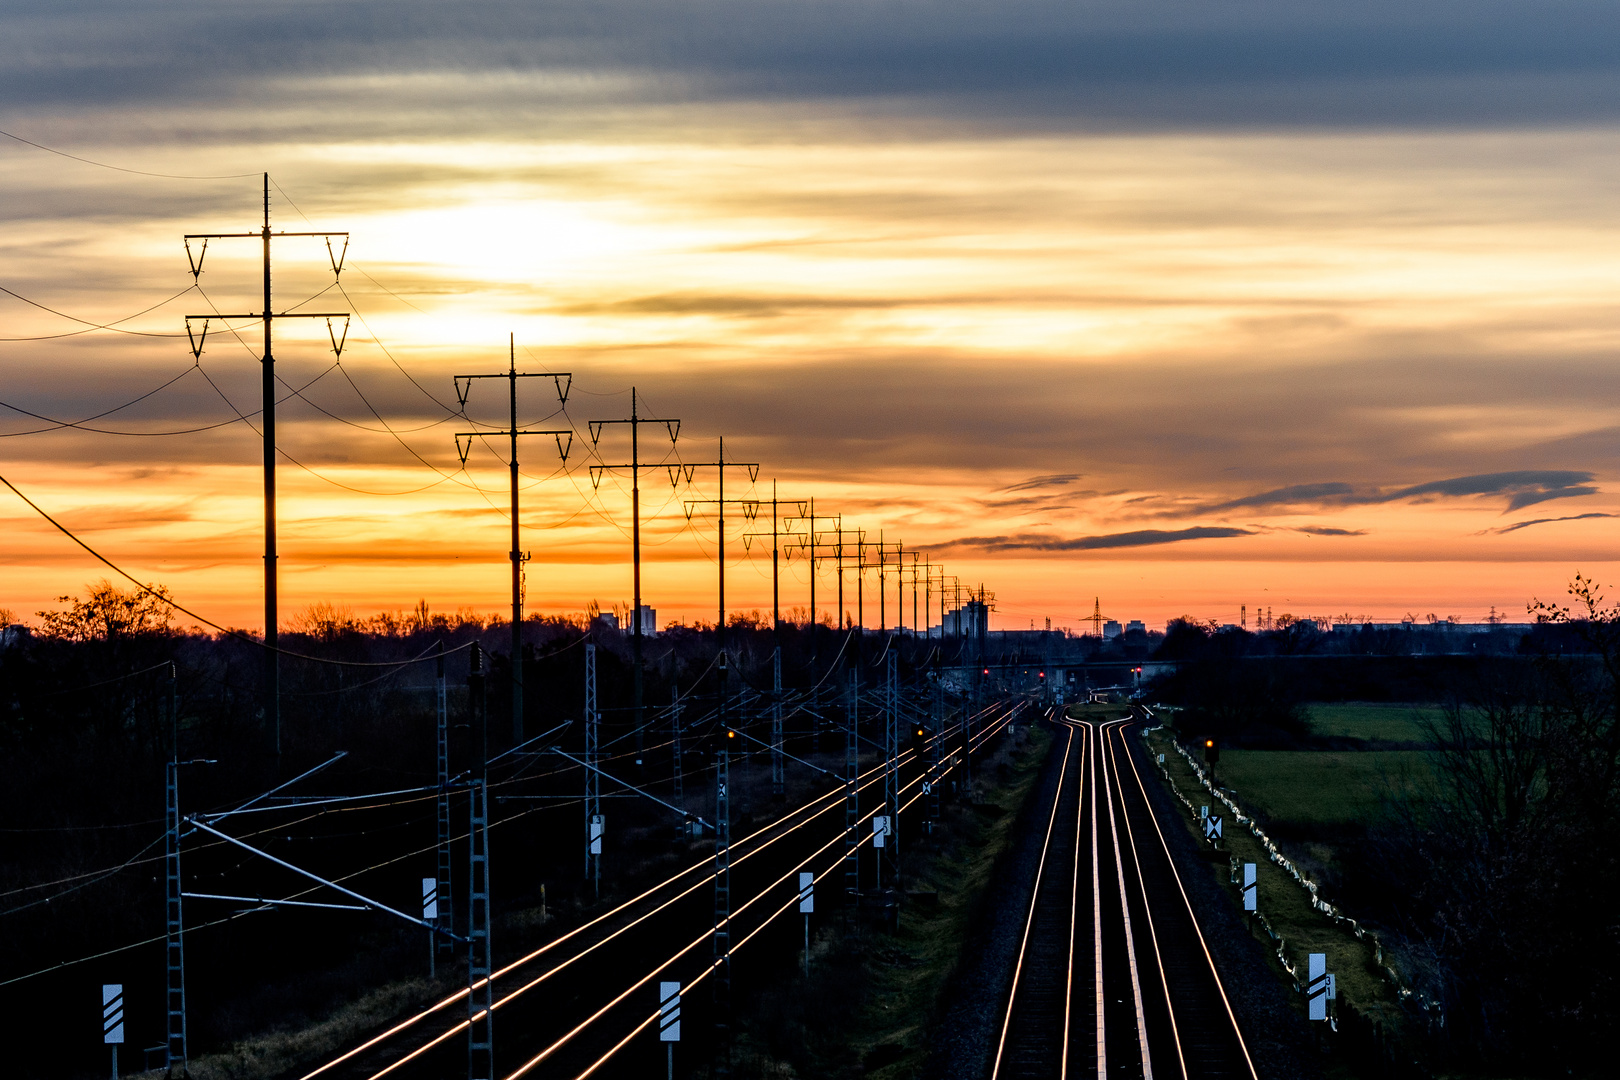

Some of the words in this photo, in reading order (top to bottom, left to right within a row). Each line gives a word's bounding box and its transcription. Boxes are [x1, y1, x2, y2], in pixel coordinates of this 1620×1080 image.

[596, 815, 601, 824] 3
[883, 817, 887, 825] 3
[1325, 976, 1331, 985] 3
[1327, 987, 1331, 996] 1
